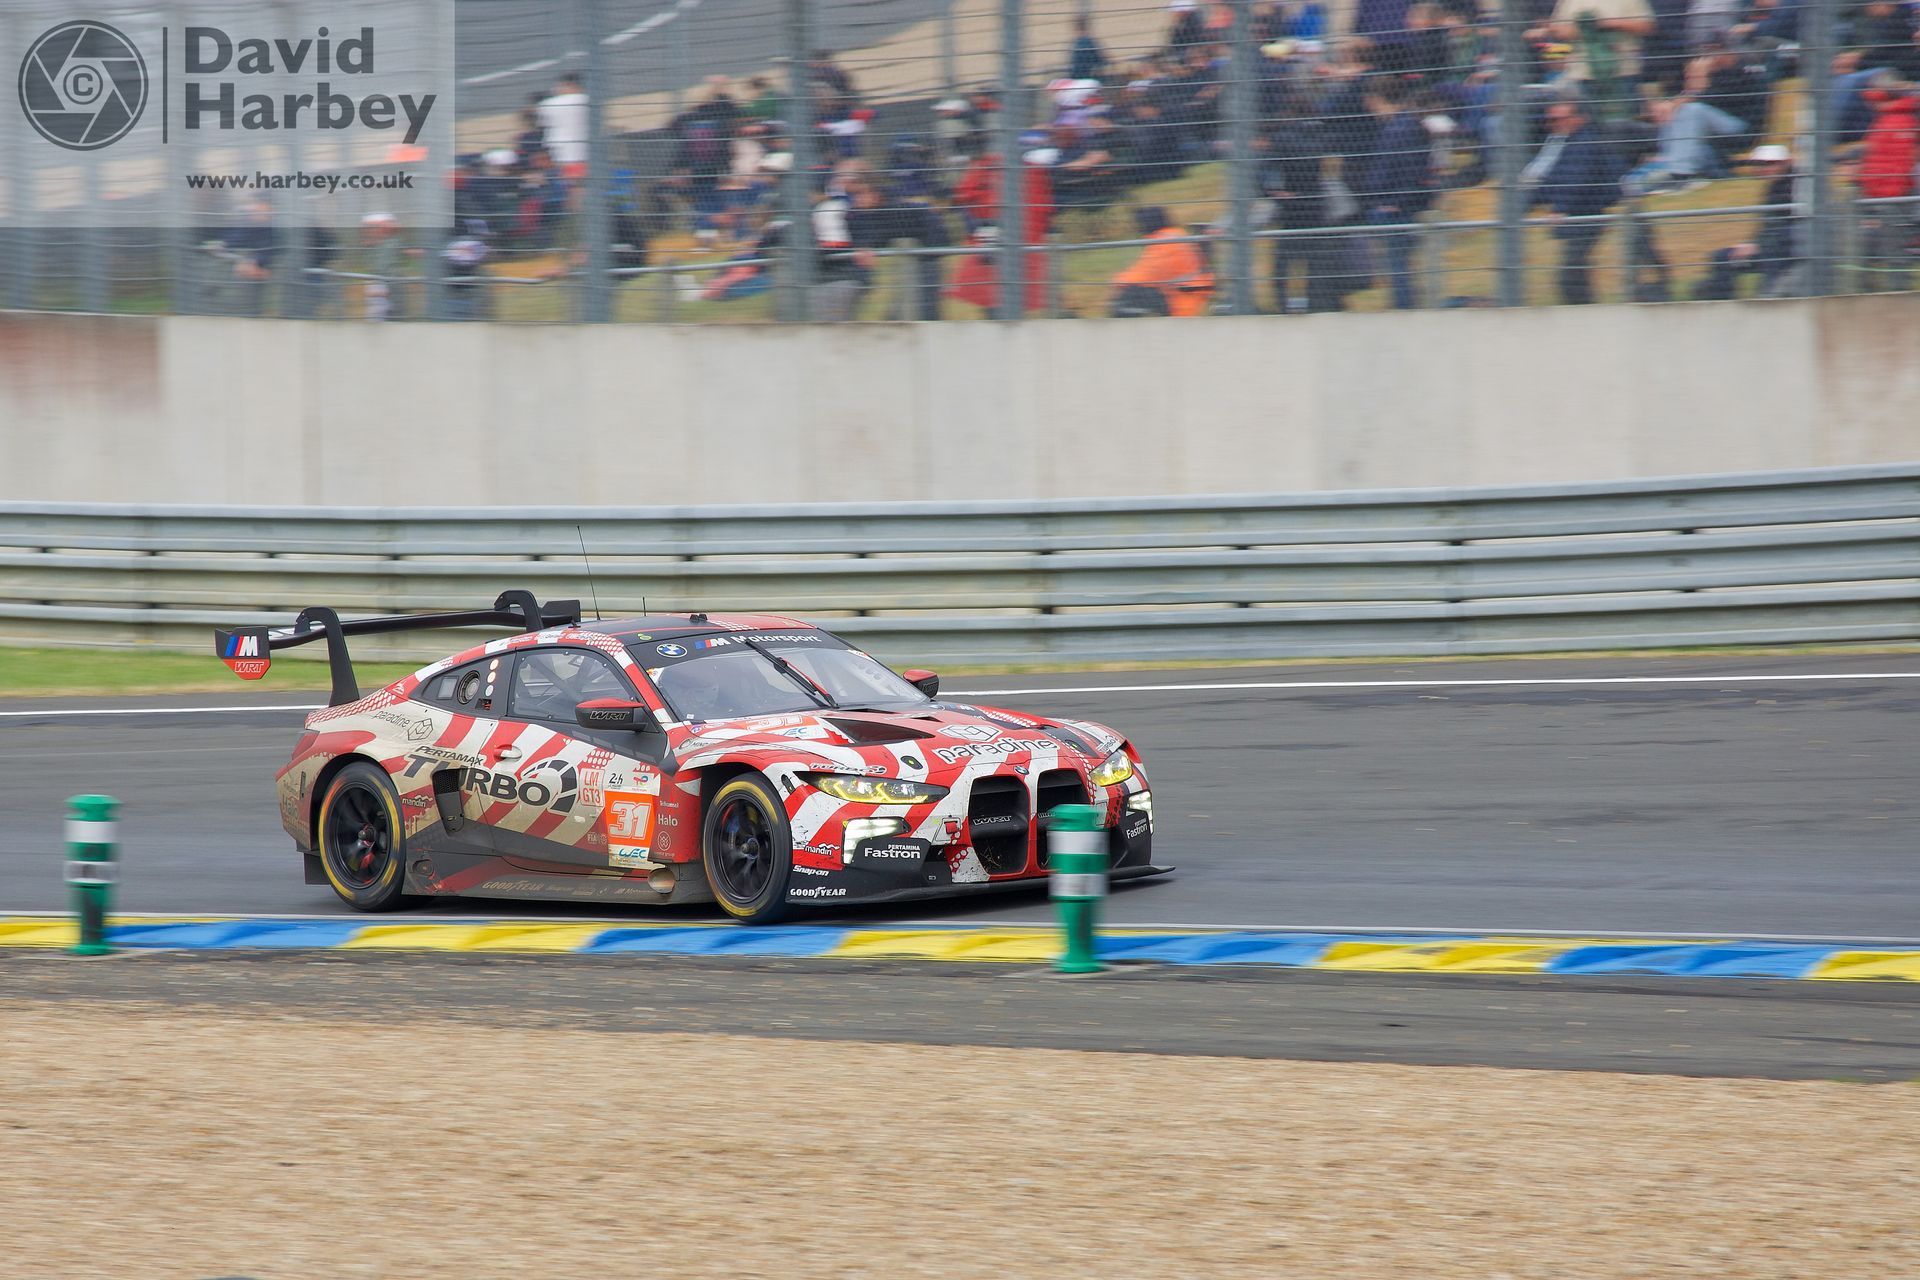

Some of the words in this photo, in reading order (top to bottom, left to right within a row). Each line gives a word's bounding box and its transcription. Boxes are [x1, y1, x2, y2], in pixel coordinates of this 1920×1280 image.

[731, 634, 822, 644] Motorsport
[235, 661, 264, 673] WRT
[374, 710, 411, 728] paradine
[590, 710, 629, 720] WRT
[415, 745, 484, 767] PERTAMAX
[936, 737, 1058, 763] paradine
[584, 770, 599, 786] LM
[583, 788, 601, 804] GT3
[608, 801, 652, 840] 31
[658, 813, 678, 827] Halo
[1126, 823, 1148, 840] Fastron
[618, 847, 647, 860] WEC
[864, 847, 921, 859] Fastron
[792, 865, 830, 877] Snap-on
[482, 879, 545, 892] GOODYEAR
[790, 886, 846, 898] GOODYEAR
